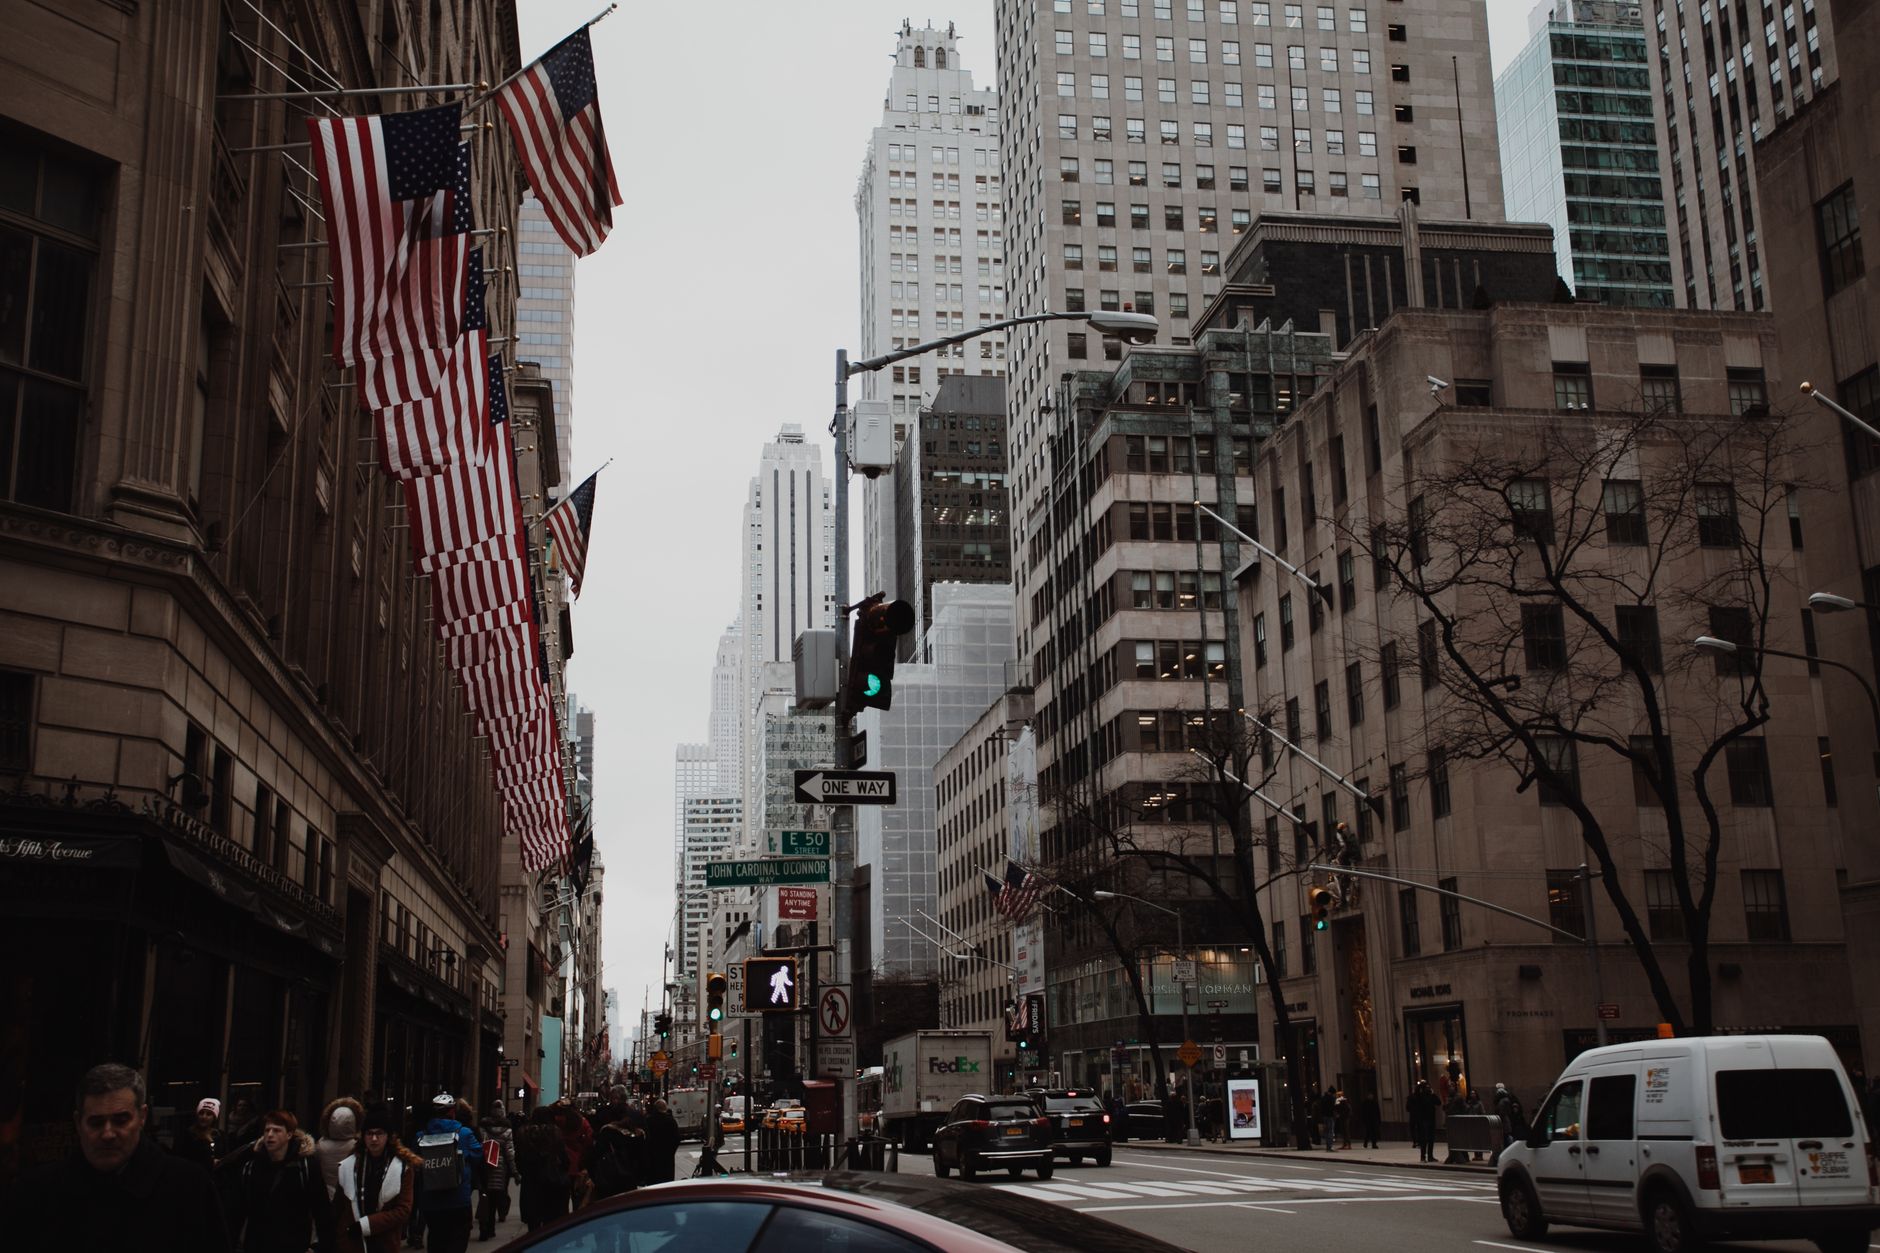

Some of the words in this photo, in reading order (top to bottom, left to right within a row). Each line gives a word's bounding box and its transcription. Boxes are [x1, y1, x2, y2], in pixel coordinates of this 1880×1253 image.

[822, 781, 850, 794] ONE
[857, 781, 885, 794] WAY
[790, 832, 798, 845] E
[805, 832, 824, 845] 50
[43, 840, 93, 860] Avenue
[708, 864, 733, 878] JOHN
[736, 862, 780, 877] CARDINAL
[780, 889, 788, 897] NO
[790, 890, 816, 899] STANDING
[785, 899, 811, 907] ANYTIME
[730, 967, 744, 979] ST
[929, 1056, 980, 1073] FedEx
[424, 1156, 452, 1169] RELAY
